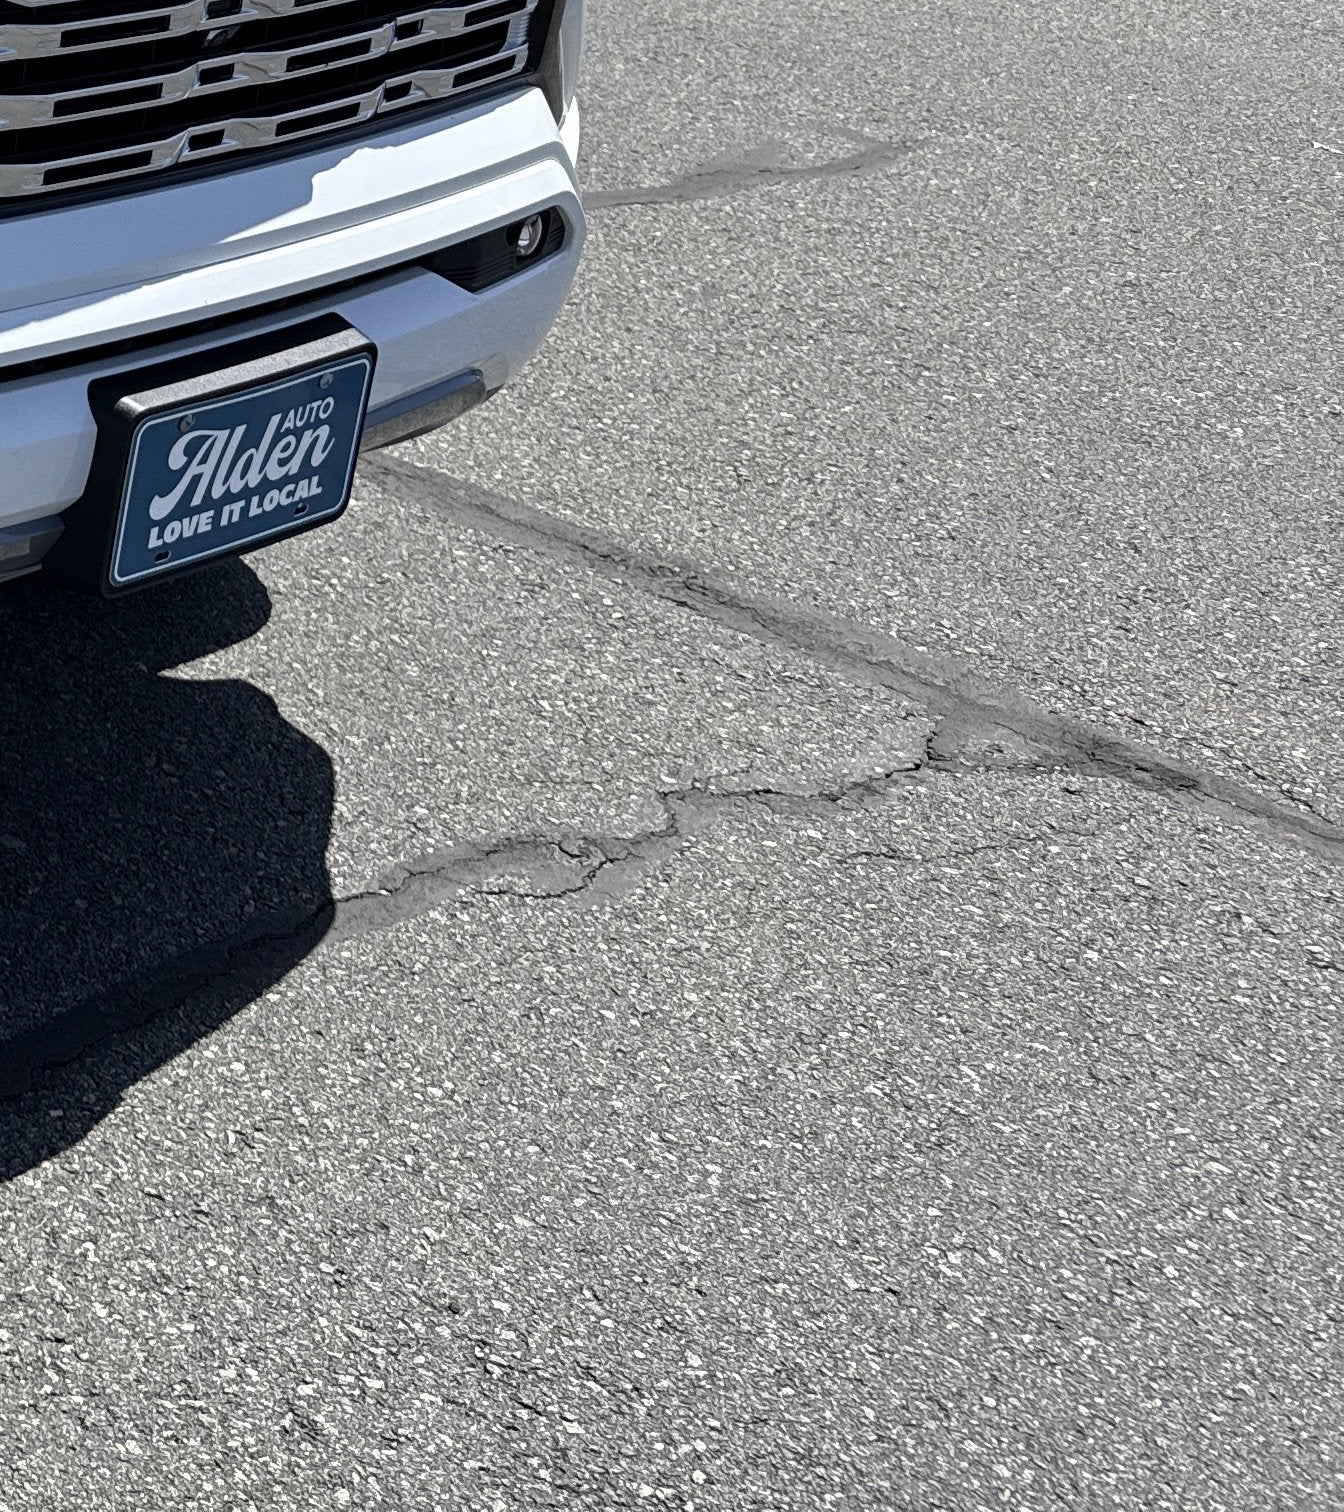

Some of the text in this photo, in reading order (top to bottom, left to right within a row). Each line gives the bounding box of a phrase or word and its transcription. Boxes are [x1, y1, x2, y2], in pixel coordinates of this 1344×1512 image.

[281, 396, 335, 433] AUTO
[148, 412, 336, 522] Alden
[147, 474, 323, 550] LOVE IT LOCAL
